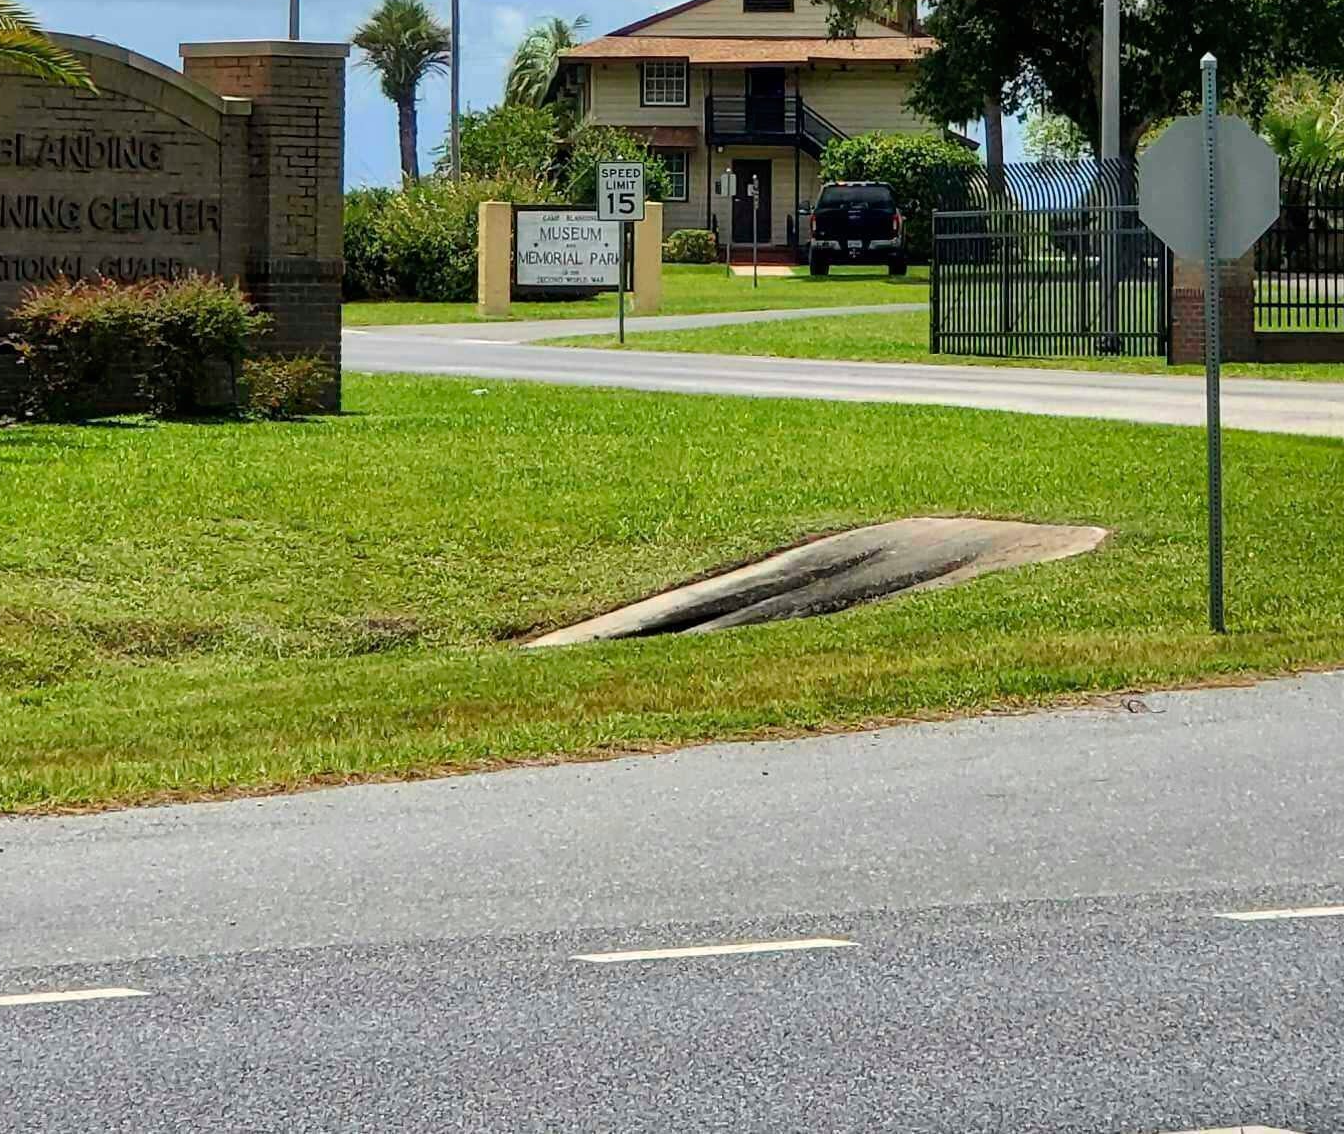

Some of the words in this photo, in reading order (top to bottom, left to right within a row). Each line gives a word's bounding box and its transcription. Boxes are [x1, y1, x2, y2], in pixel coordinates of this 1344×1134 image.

[601, 168, 641, 178] SPEED
[606, 179, 636, 190] LIMIT
[607, 192, 636, 214] 15
[87, 197, 221, 232] CENTER
[540, 226, 602, 241] MUSEUM
[518, 250, 583, 265] MEMORIAL
